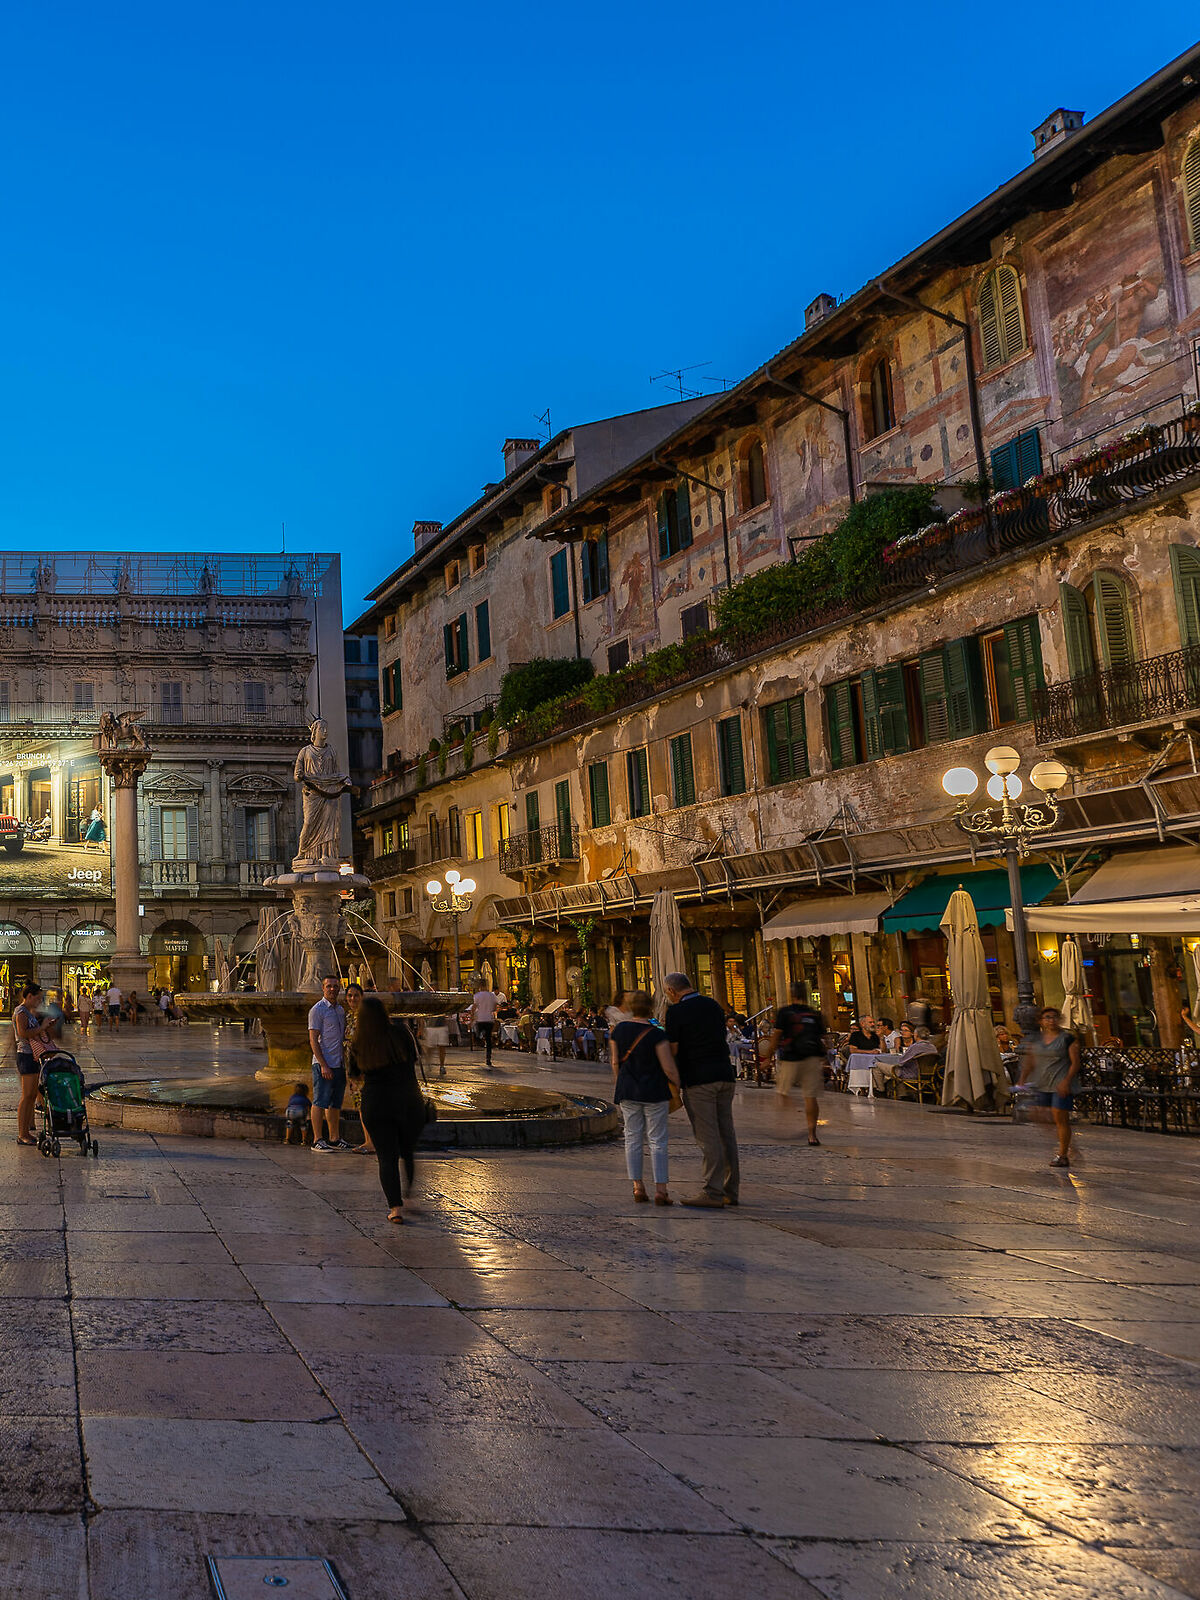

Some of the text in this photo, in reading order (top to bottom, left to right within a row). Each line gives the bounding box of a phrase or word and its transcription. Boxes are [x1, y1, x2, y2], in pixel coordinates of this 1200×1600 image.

[16, 752, 46, 760] BRUNCH
[67, 867, 102, 881] Jeep
[68, 966, 97, 975] SALE
